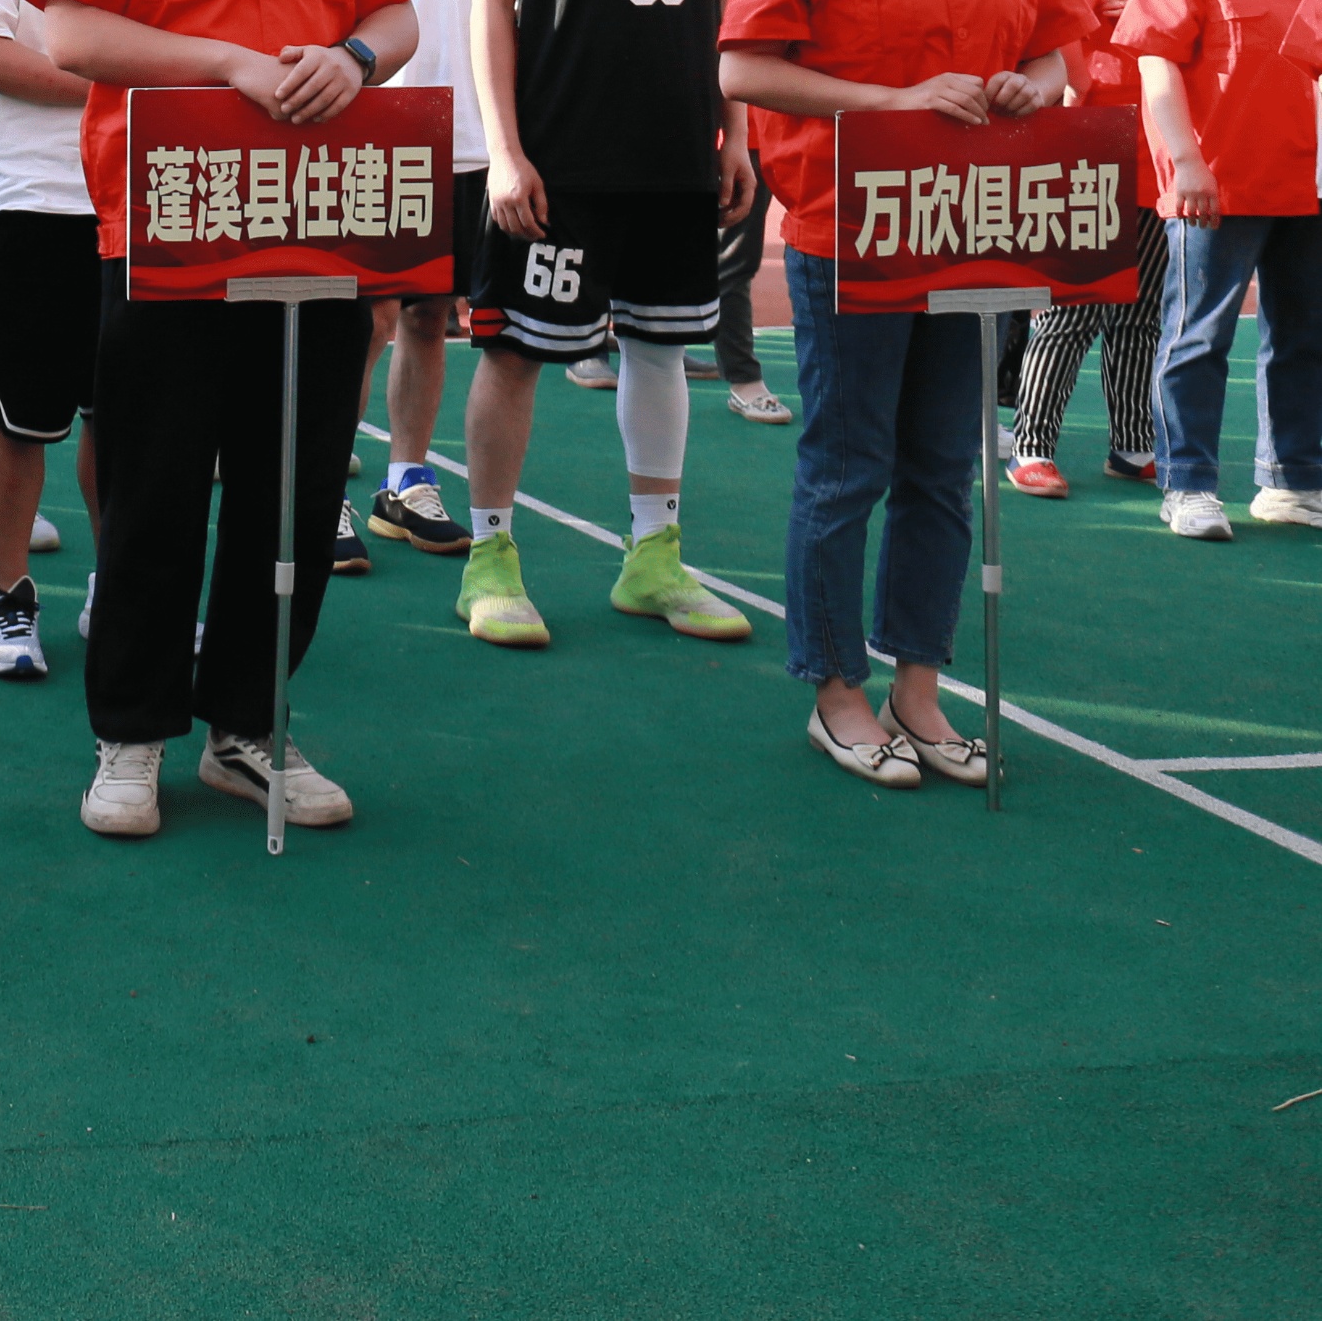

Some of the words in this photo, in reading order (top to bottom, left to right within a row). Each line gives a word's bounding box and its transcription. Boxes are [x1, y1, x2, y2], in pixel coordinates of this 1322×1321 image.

[146, 143, 435, 243] 蓬溪县住建局
[853, 158, 1121, 258] 万欣俱乐部
[523, 242, 584, 303] 66
